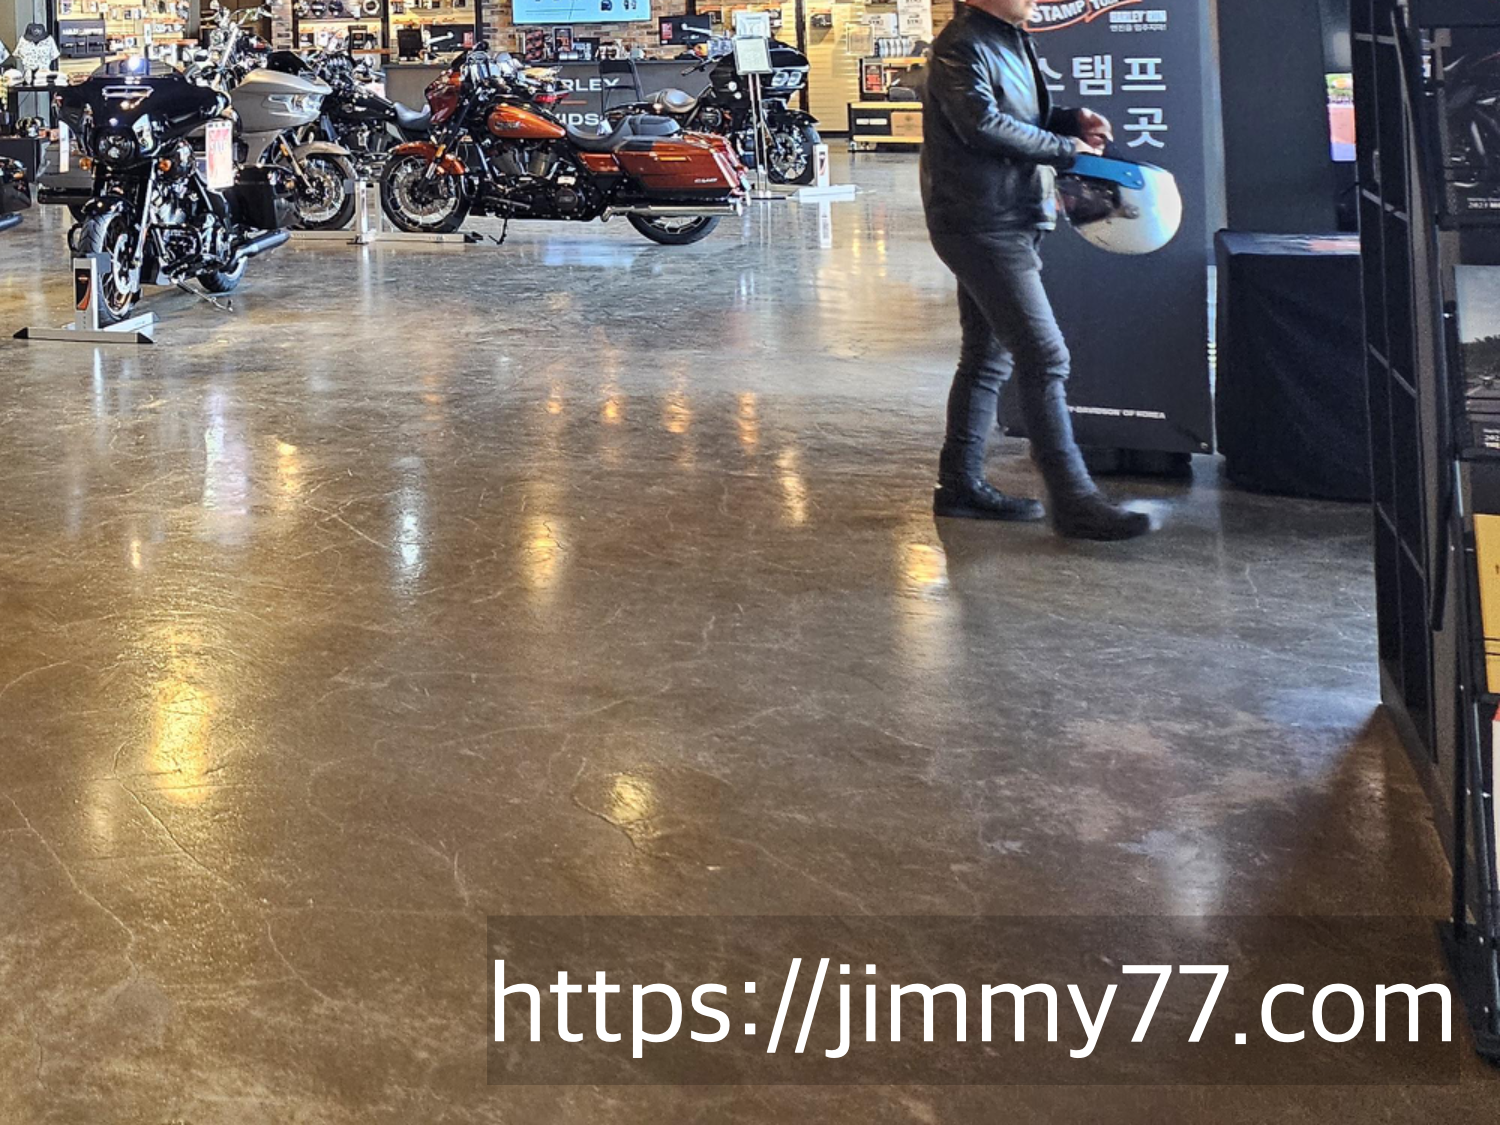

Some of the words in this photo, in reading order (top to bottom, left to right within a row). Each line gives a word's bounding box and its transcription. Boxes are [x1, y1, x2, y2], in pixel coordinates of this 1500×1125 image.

[1031, 0, 1085, 23] STAMP
[559, 77, 620, 92] RLEY
[1123, 108, 1168, 148] 곳
